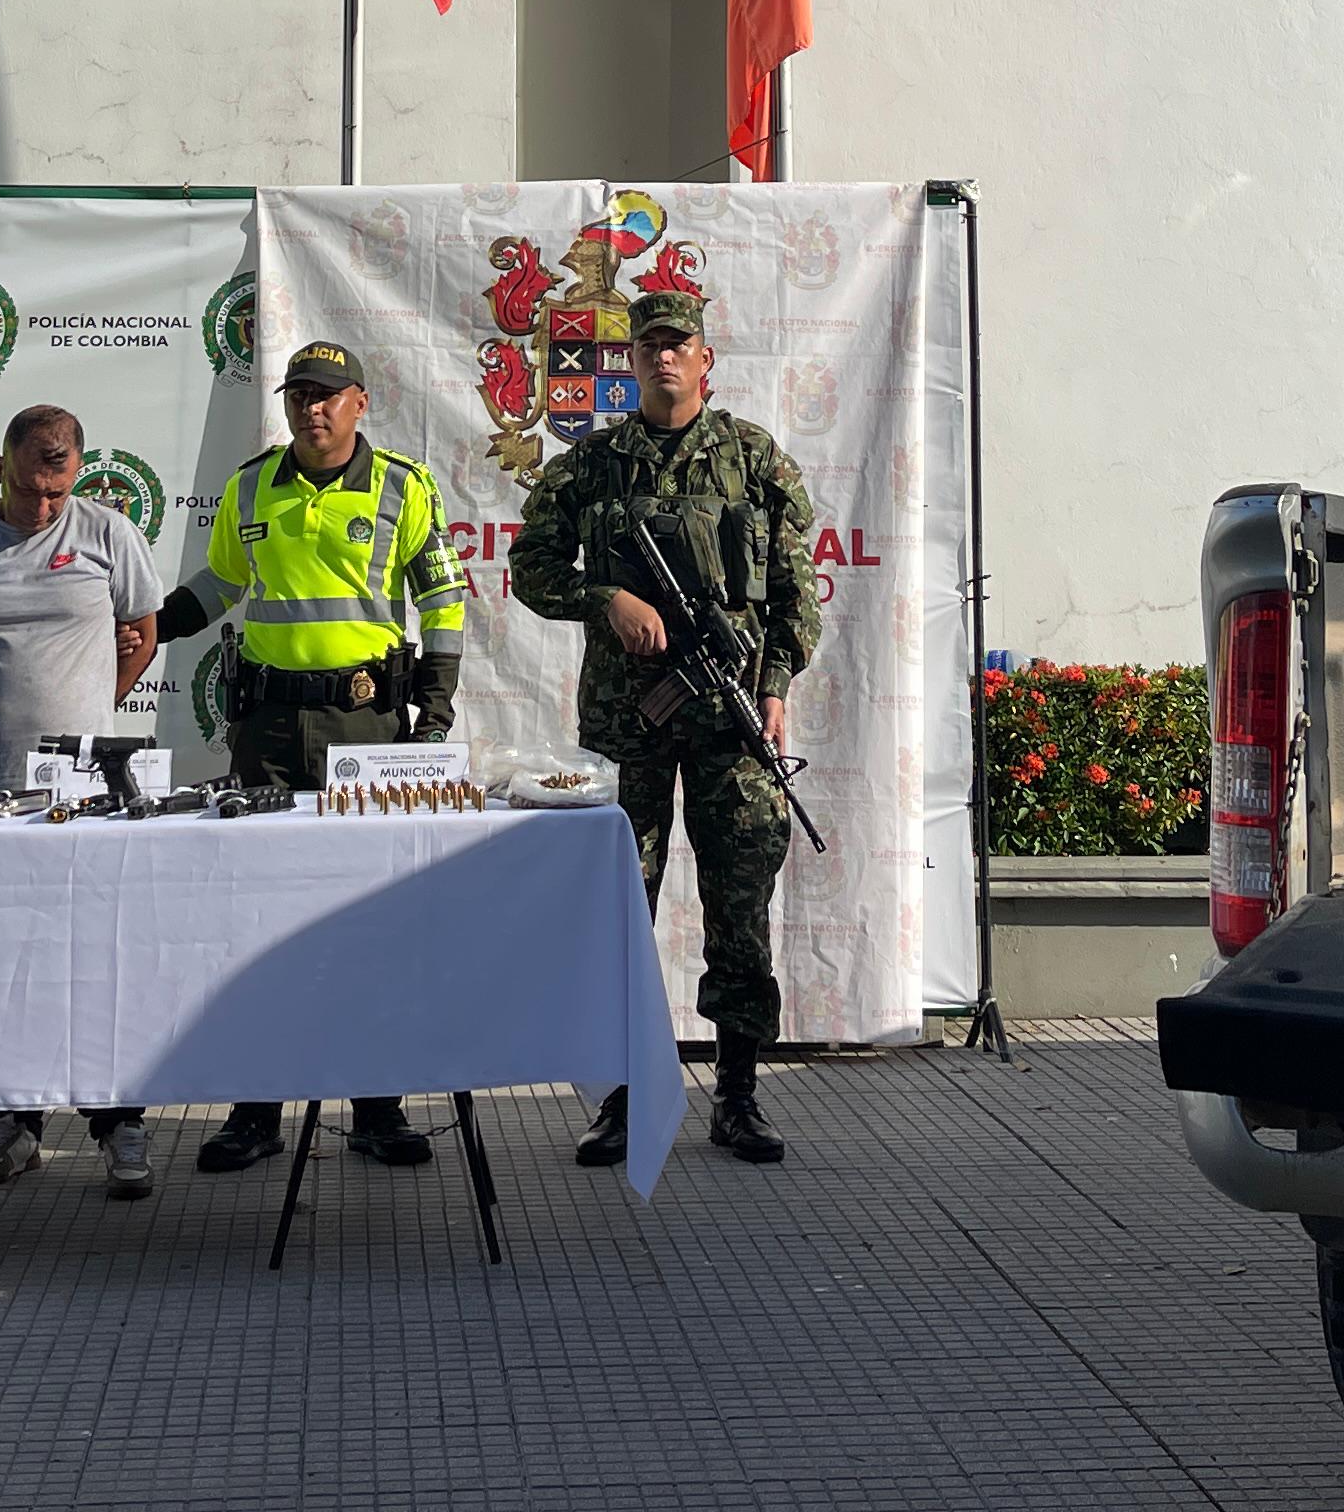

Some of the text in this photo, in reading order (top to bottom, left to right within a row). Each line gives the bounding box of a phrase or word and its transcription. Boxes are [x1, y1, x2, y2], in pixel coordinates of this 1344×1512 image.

[29, 313, 192, 328] POLICÍA NACIONAL
[51, 335, 169, 347] DE COLOMBIA
[230, 369, 252, 383] DIOS
[123, 467, 150, 515] COLOMBIA
[176, 496, 223, 508] POLIC
[380, 764, 445, 778] MUNICIÓN
